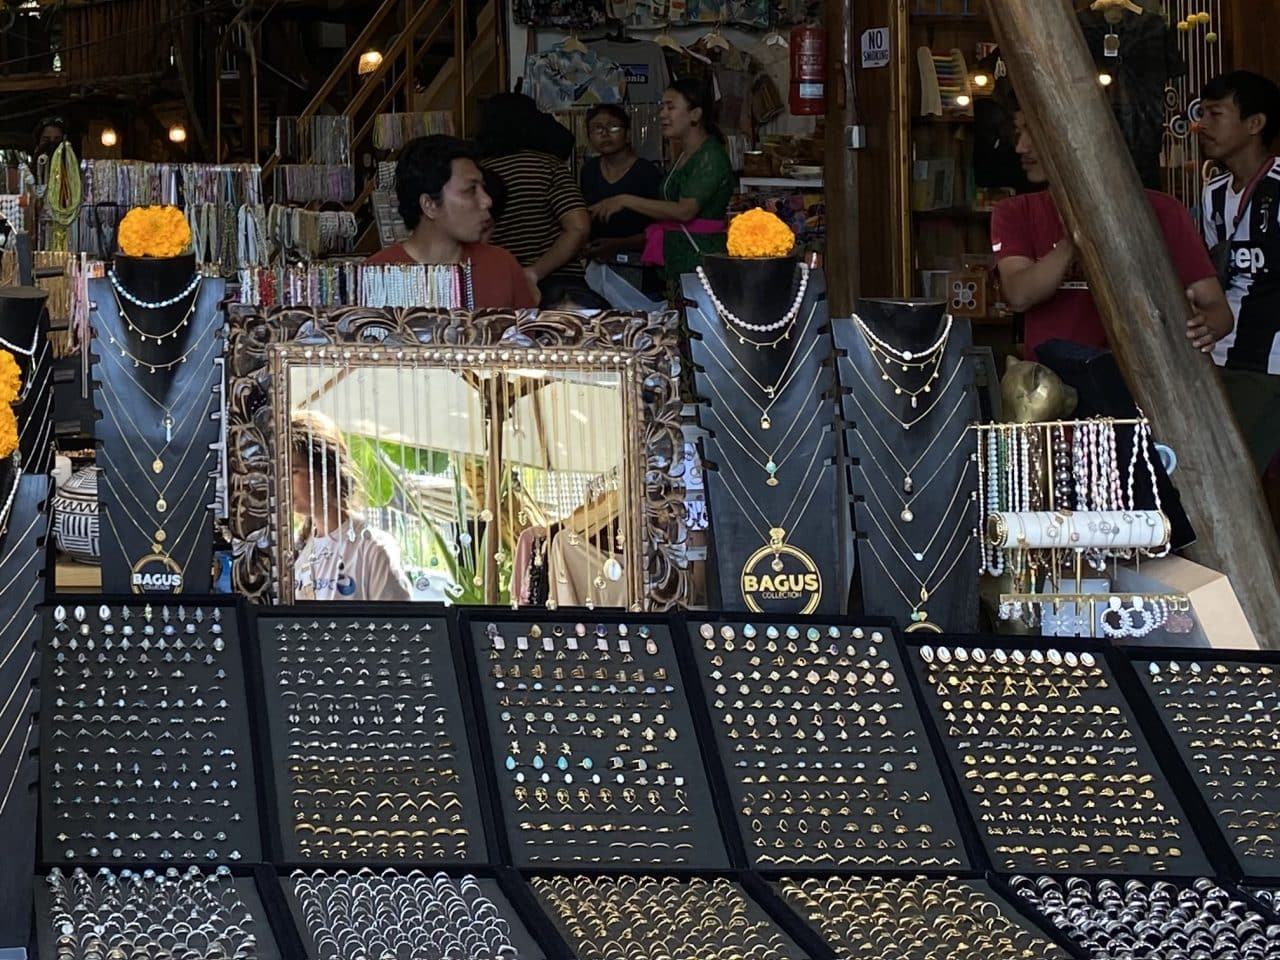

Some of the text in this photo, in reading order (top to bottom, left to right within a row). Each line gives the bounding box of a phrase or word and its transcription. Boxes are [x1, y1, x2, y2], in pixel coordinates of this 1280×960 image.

[869, 30, 883, 50] NO
[132, 573, 183, 586] BAGUS
[744, 573, 819, 592] BAGUS
[761, 590, 803, 600] COLLECTION
